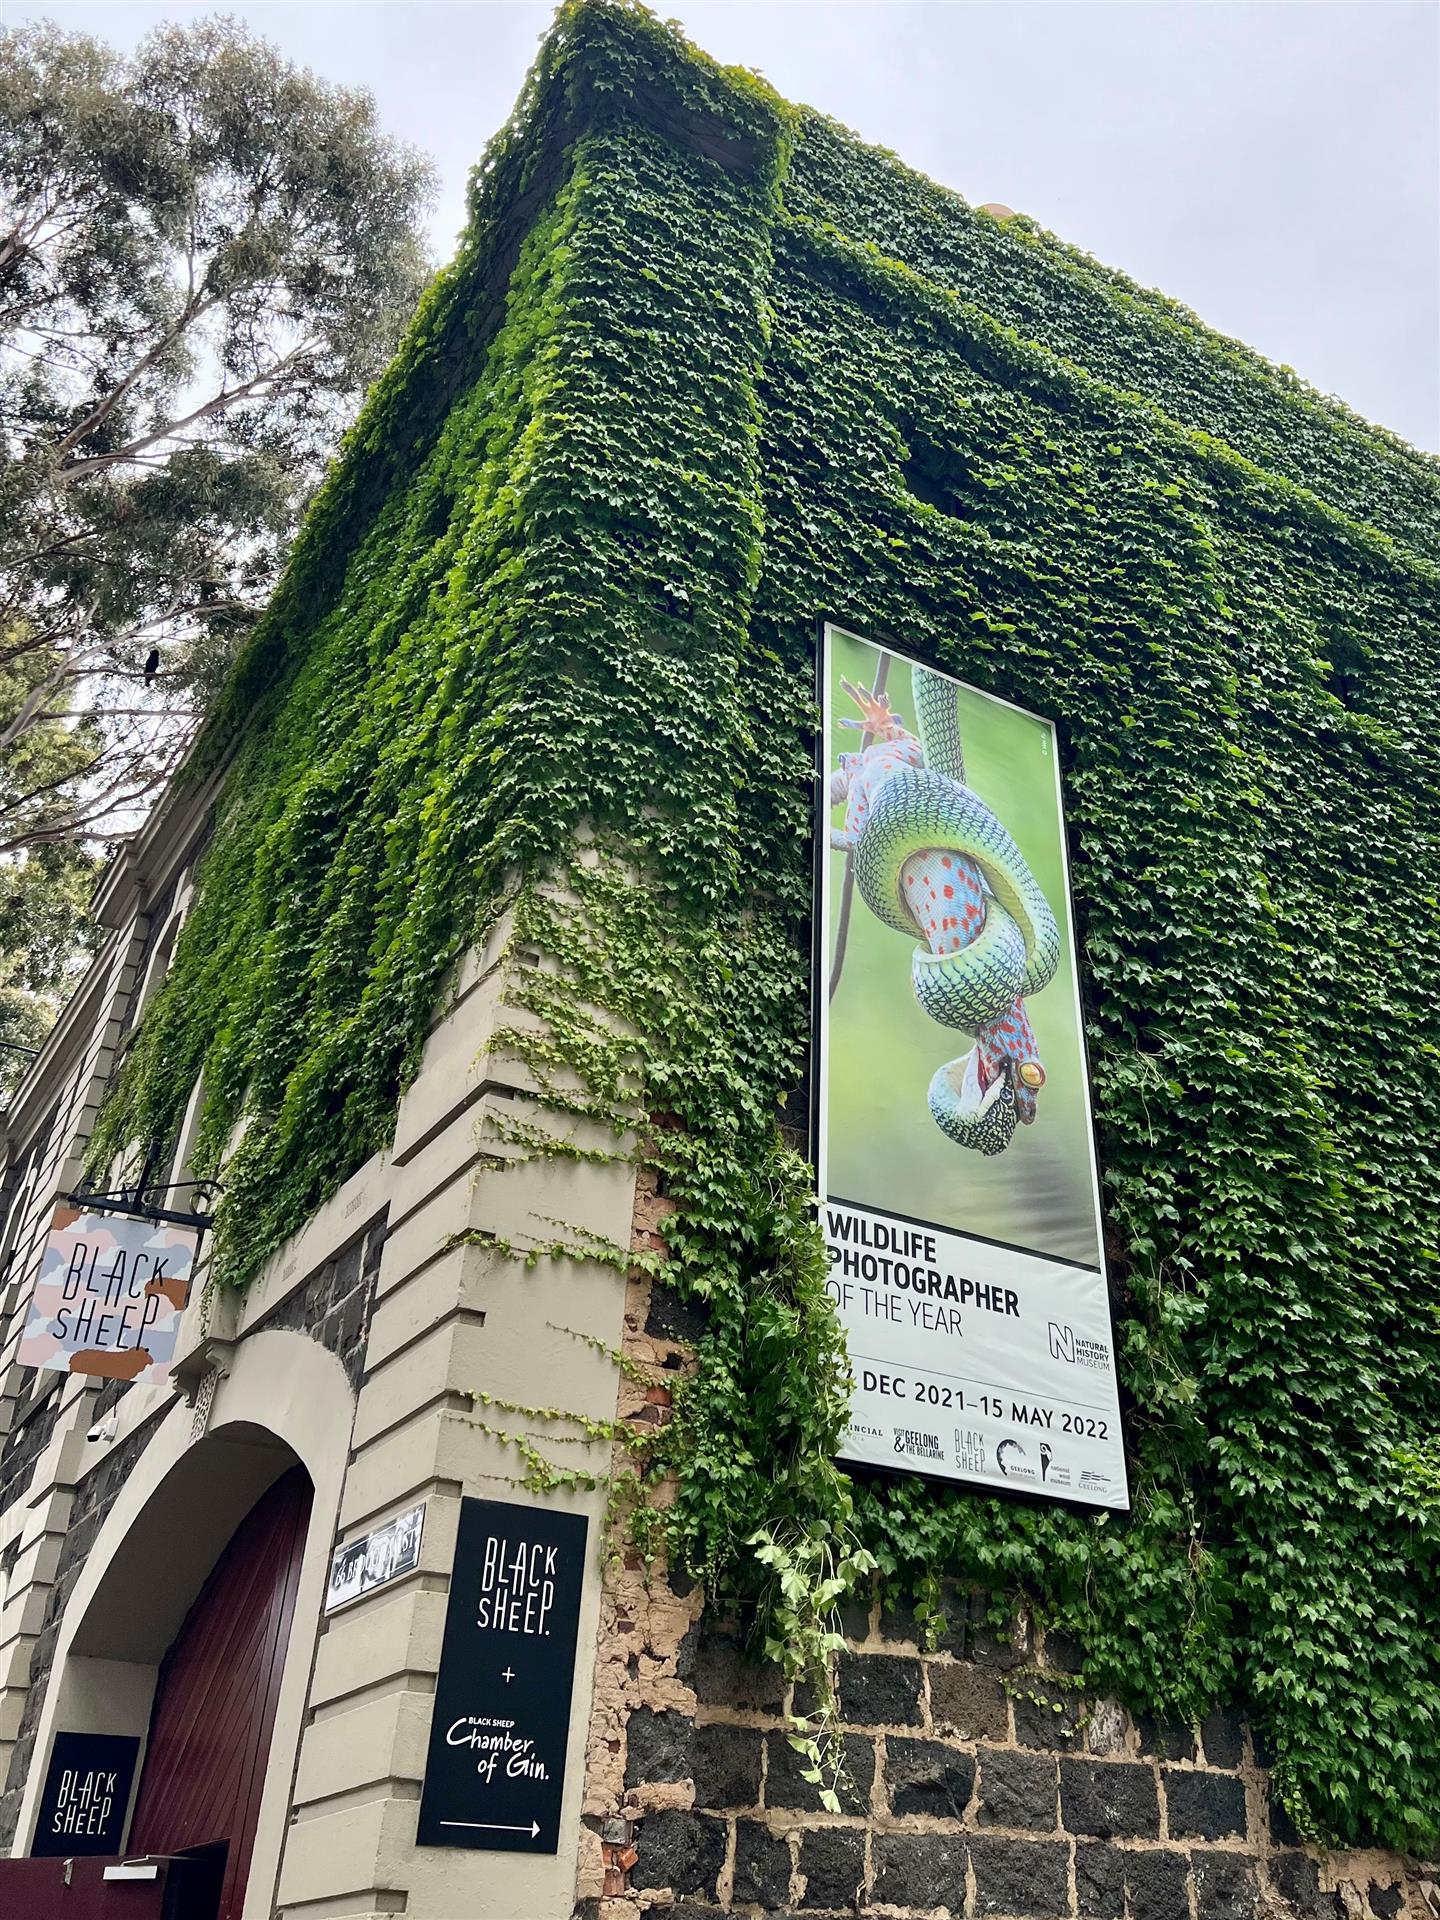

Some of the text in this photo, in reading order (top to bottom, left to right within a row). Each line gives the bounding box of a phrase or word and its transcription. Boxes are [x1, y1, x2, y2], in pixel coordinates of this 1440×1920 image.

[826, 1210, 937, 1263] WILDLIFE
[62, 1242, 170, 1309] BLACK
[827, 1245, 1020, 1318] PHOTOGRAPHER
[826, 1280, 963, 1337] OF THE YEAR
[1075, 1338, 1109, 1354] NATURAL
[1076, 1347, 1109, 1362] HISTORY
[1076, 1356, 1110, 1372] MUSEUM
[863, 1370, 906, 1398] DEC
[1011, 1402, 1053, 1429] MAY
[1061, 1413, 1109, 1441] 2022
[847, 1422, 884, 1437] INCIAL
[905, 1430, 939, 1450] GEELONG
[954, 1428, 985, 1455] BLACK
[906, 1443, 916, 1456] THE
[916, 1446, 945, 1461] BELLARINE
[1010, 1465, 1036, 1475] GEELONG
[481, 1536, 559, 1596] BLACK
[477, 1580, 554, 1636] SHEEP.
[446, 1717, 534, 1753] Chamber
[468, 1716, 515, 1728] BLACK SHEEP
[477, 1752, 549, 1784] of Gin.
[57, 1769, 118, 1810] BLACK
[51, 1797, 112, 1836] SHEEP.
